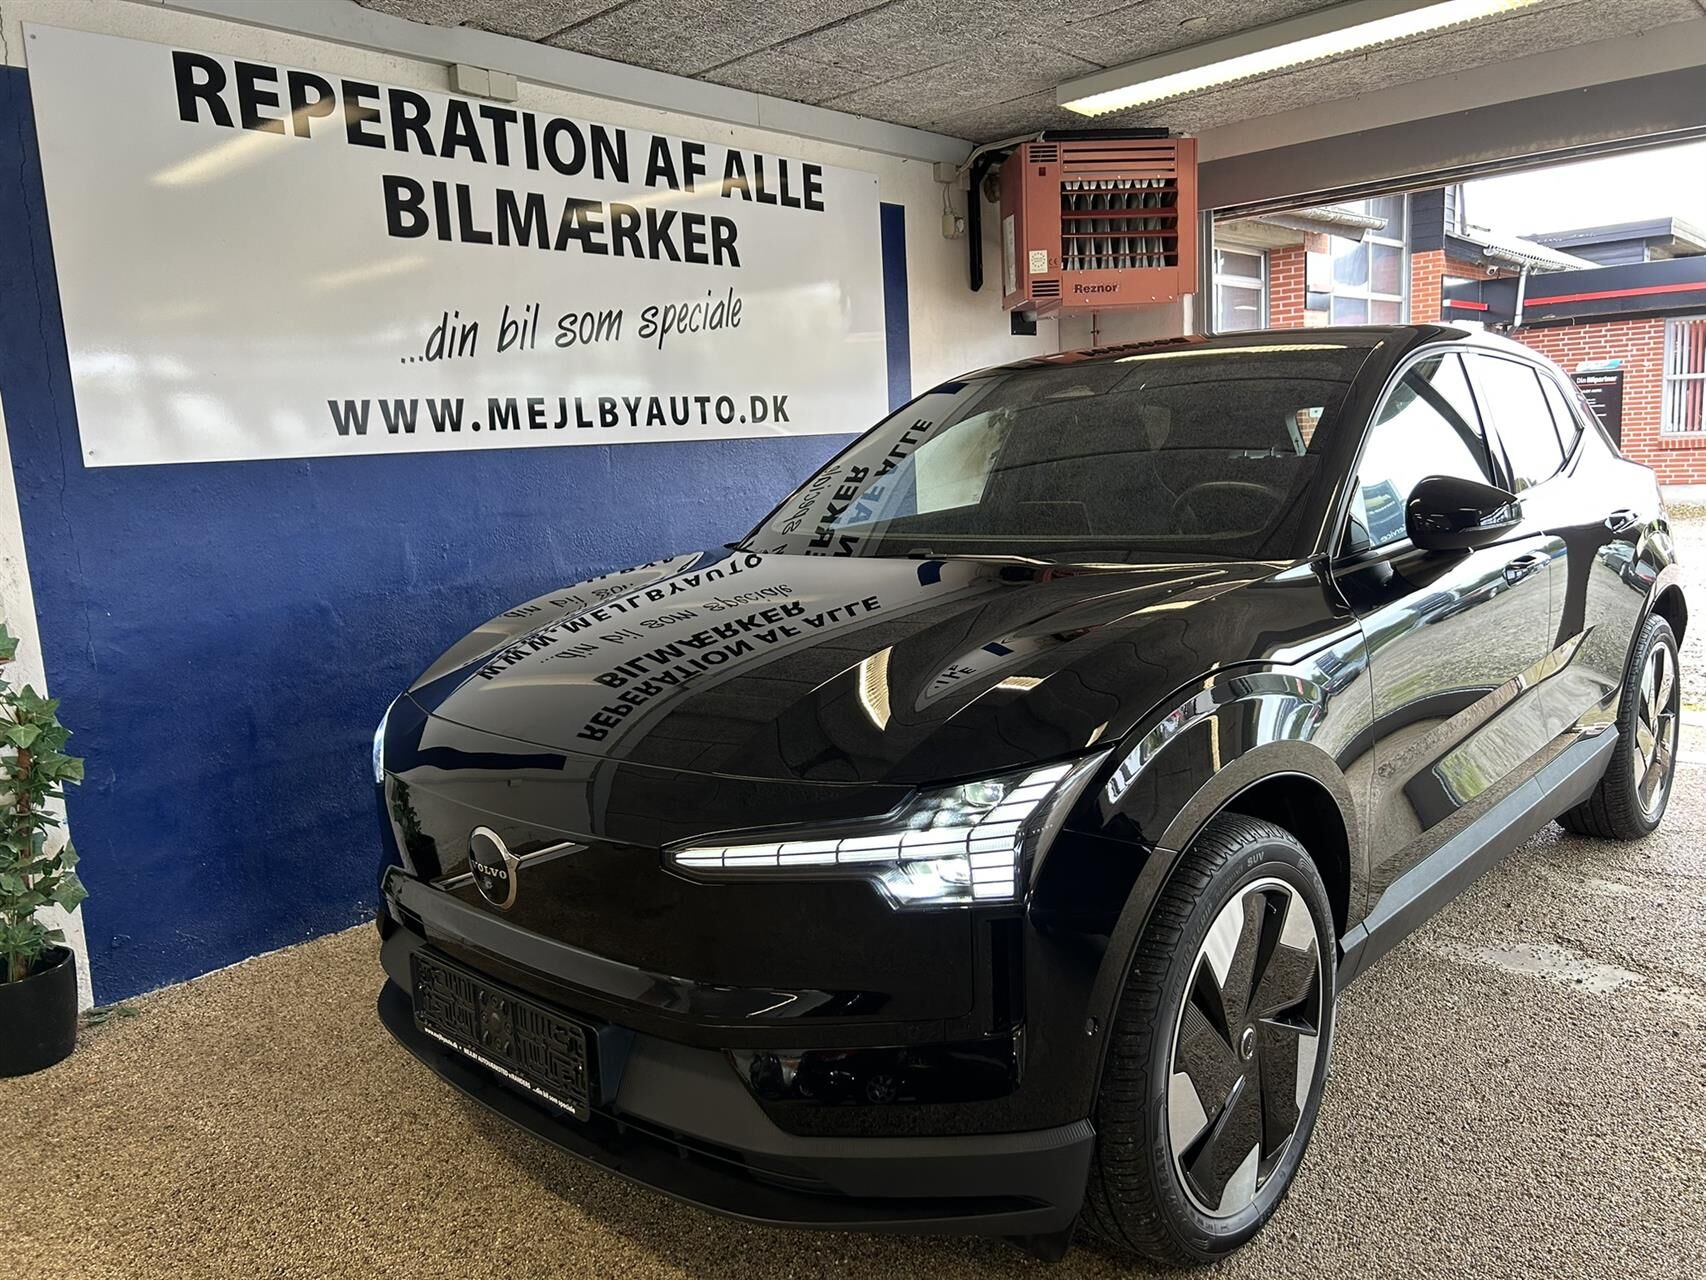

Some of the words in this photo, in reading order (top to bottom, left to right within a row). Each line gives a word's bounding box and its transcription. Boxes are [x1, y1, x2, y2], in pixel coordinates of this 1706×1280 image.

[172, 50, 629, 184] REPERATION
[645, 136, 706, 194] AF
[721, 149, 825, 212] ALLE
[382, 174, 741, 268] BILMÆRKER
[1074, 284, 1119, 294] Reznor
[400, 312, 479, 364] ...din
[497, 304, 538, 354] bil
[557, 311, 623, 349] som
[638, 287, 743, 351] speciale
[328, 394, 791, 436] WWW.MEJLBYAUTO.DK
[472, 860, 507, 879] VOLVO
[1247, 851, 1265, 867] SUV
